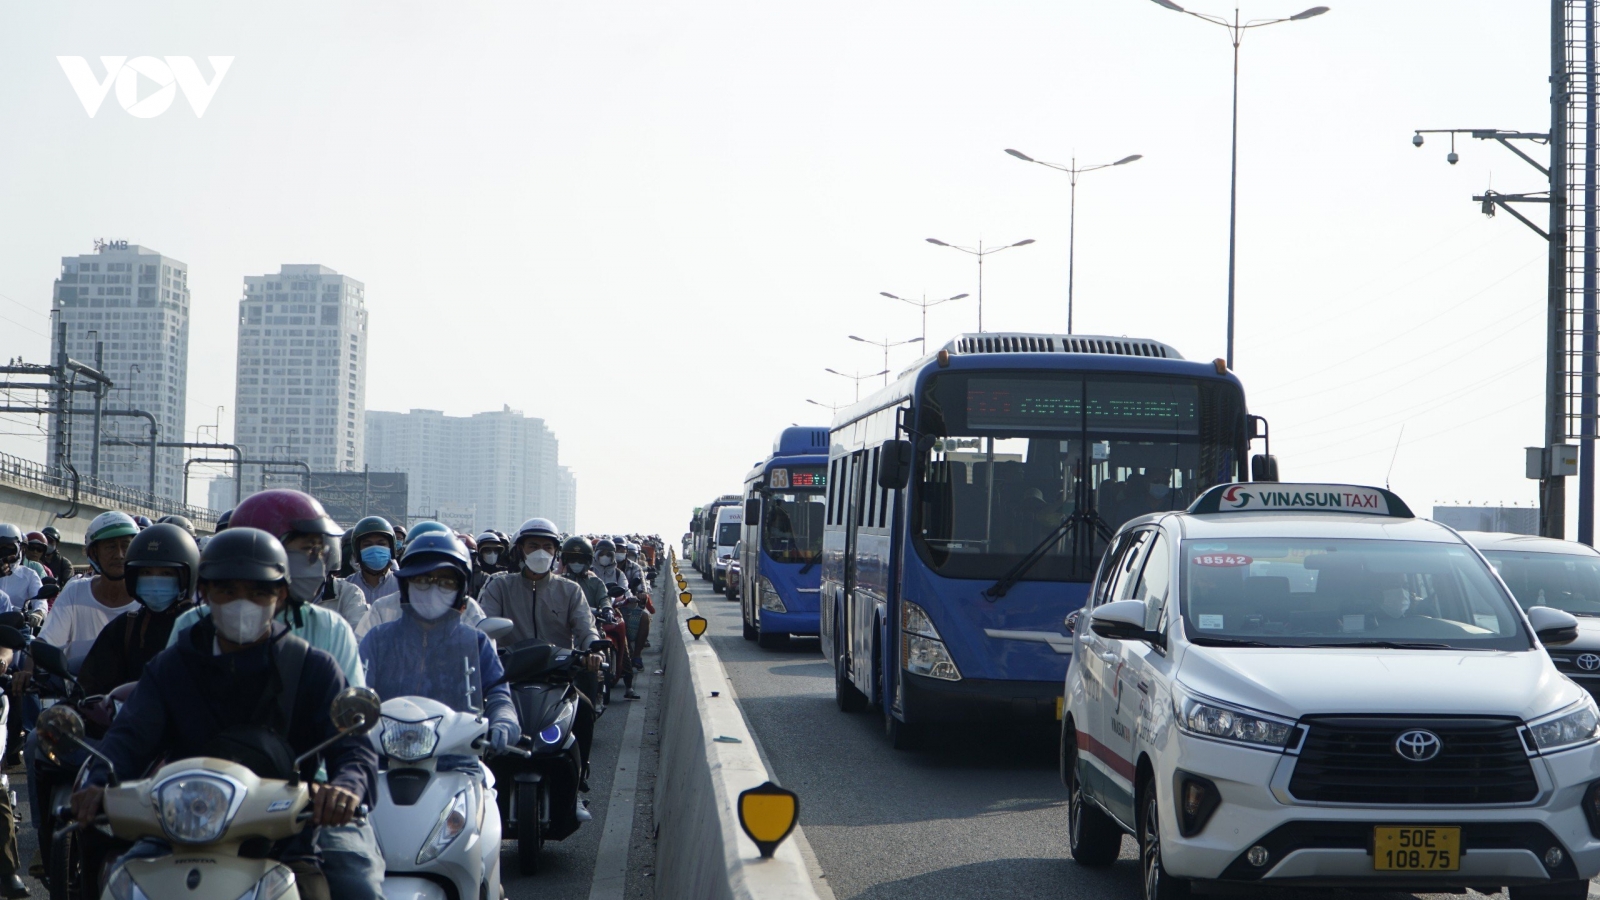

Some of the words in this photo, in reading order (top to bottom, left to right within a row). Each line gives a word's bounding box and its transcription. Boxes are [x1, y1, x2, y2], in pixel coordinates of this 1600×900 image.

[108, 240, 128, 250] MB
[772, 470, 787, 487] 53
[1194, 555, 1247, 565] 18542
[1399, 829, 1436, 848] 50E
[1386, 850, 1450, 868] 108.75
